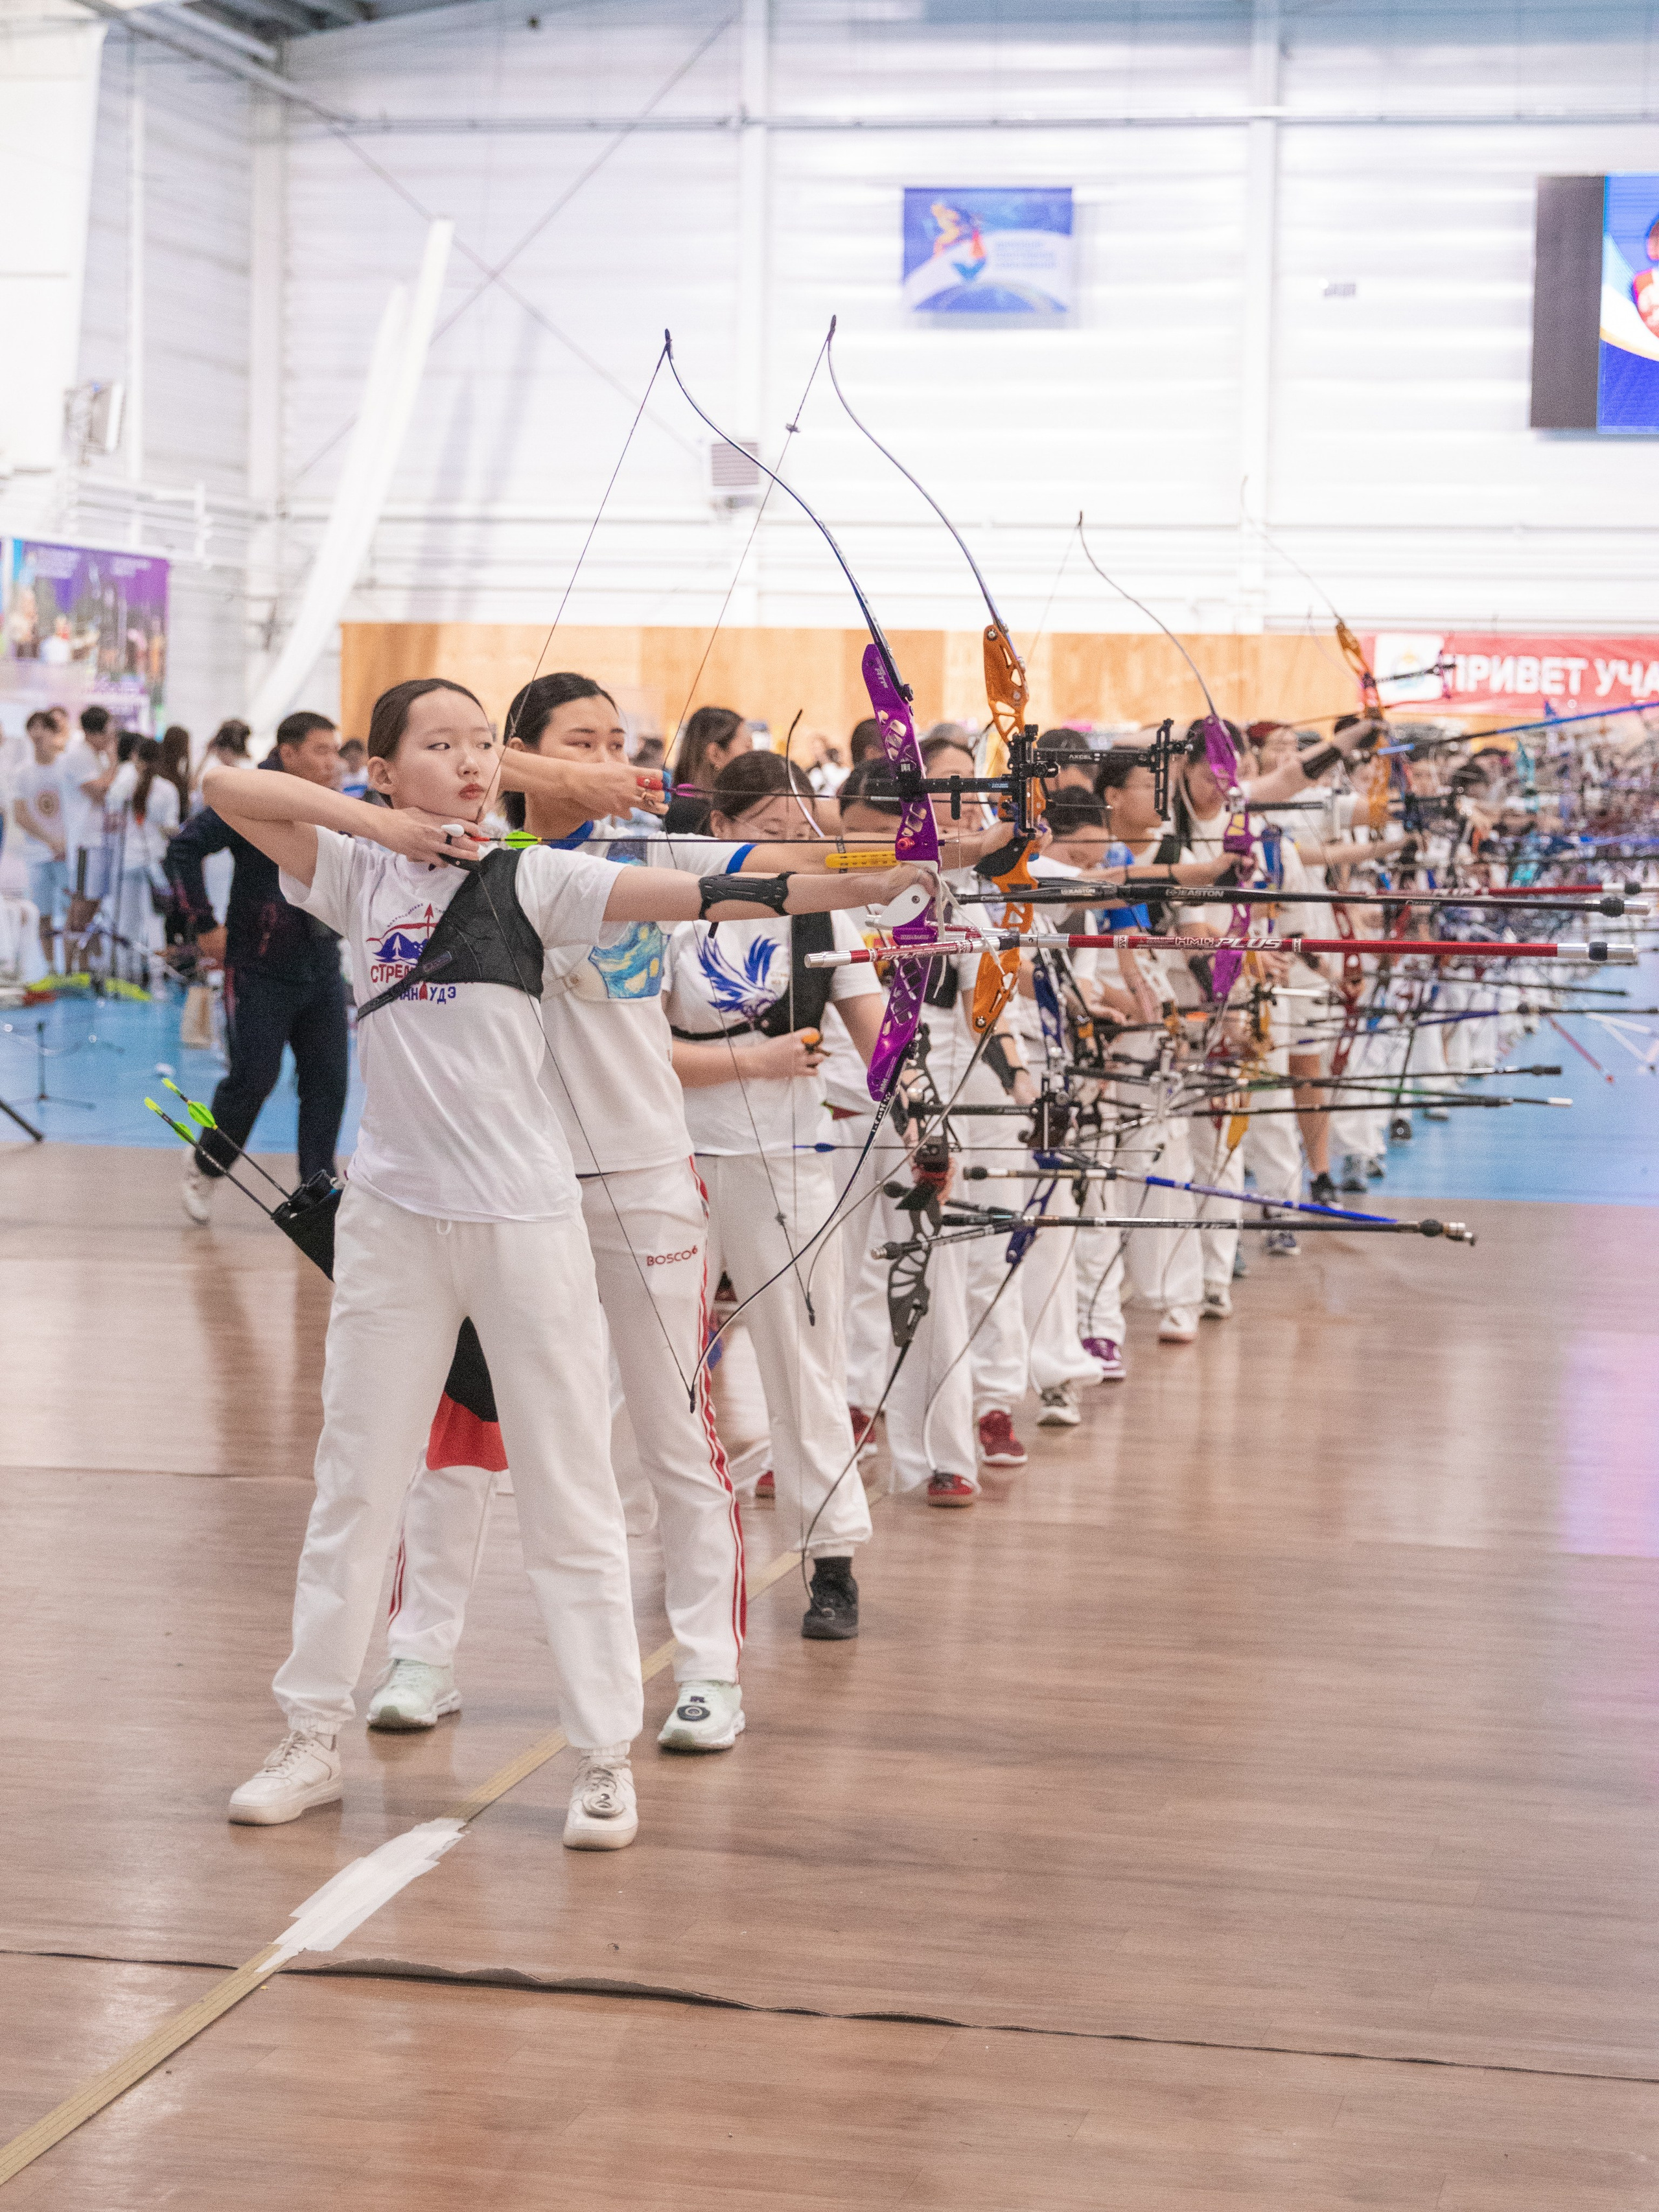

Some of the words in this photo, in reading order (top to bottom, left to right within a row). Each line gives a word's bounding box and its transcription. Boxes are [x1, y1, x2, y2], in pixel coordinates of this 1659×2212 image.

[1441, 653, 1587, 695] ПРИВЕТ
[1179, 889, 1224, 897] EASTON
[1215, 938, 1282, 949] PLUS
[647, 1250, 691, 1266] BOSCO
